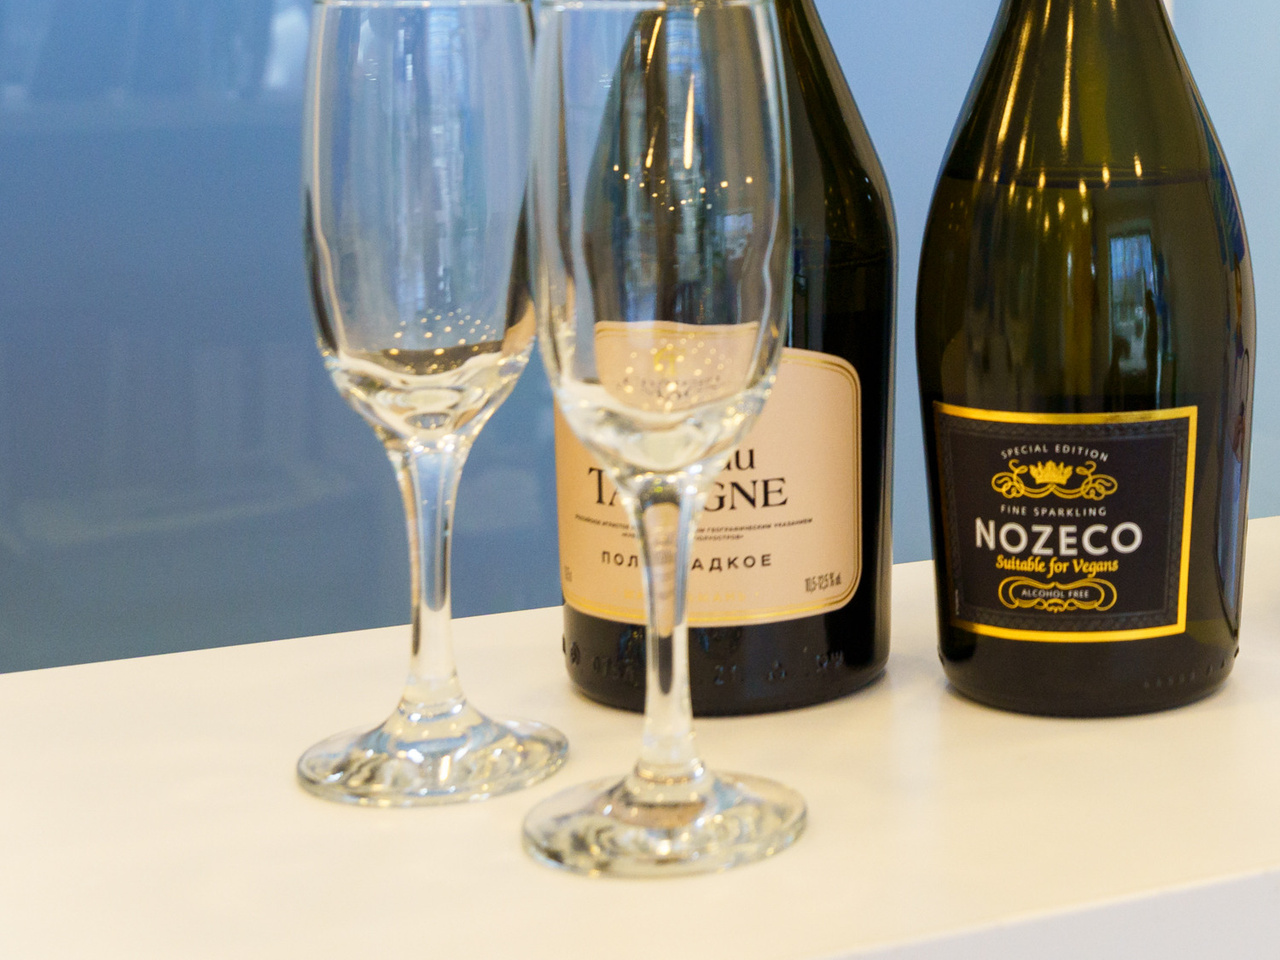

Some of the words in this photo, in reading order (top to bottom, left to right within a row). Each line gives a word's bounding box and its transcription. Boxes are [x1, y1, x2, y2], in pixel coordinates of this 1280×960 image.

[1001, 443, 1049, 459] SPECIAL
[1055, 443, 1109, 462] EDITION
[588, 467, 788, 512] TGNE
[1000, 504, 1027, 516] FINE
[1033, 506, 1107, 517] SPARKLING
[975, 517, 1143, 556] NOZECO
[601, 550, 772, 573] ПОЛАДКОЕ
[995, 554, 1046, 573] Suitable
[1046, 559, 1069, 578] for
[1073, 558, 1119, 578] Vegans
[1021, 588, 1065, 598] ALCOHOL
[1068, 589, 1089, 598] FREE
